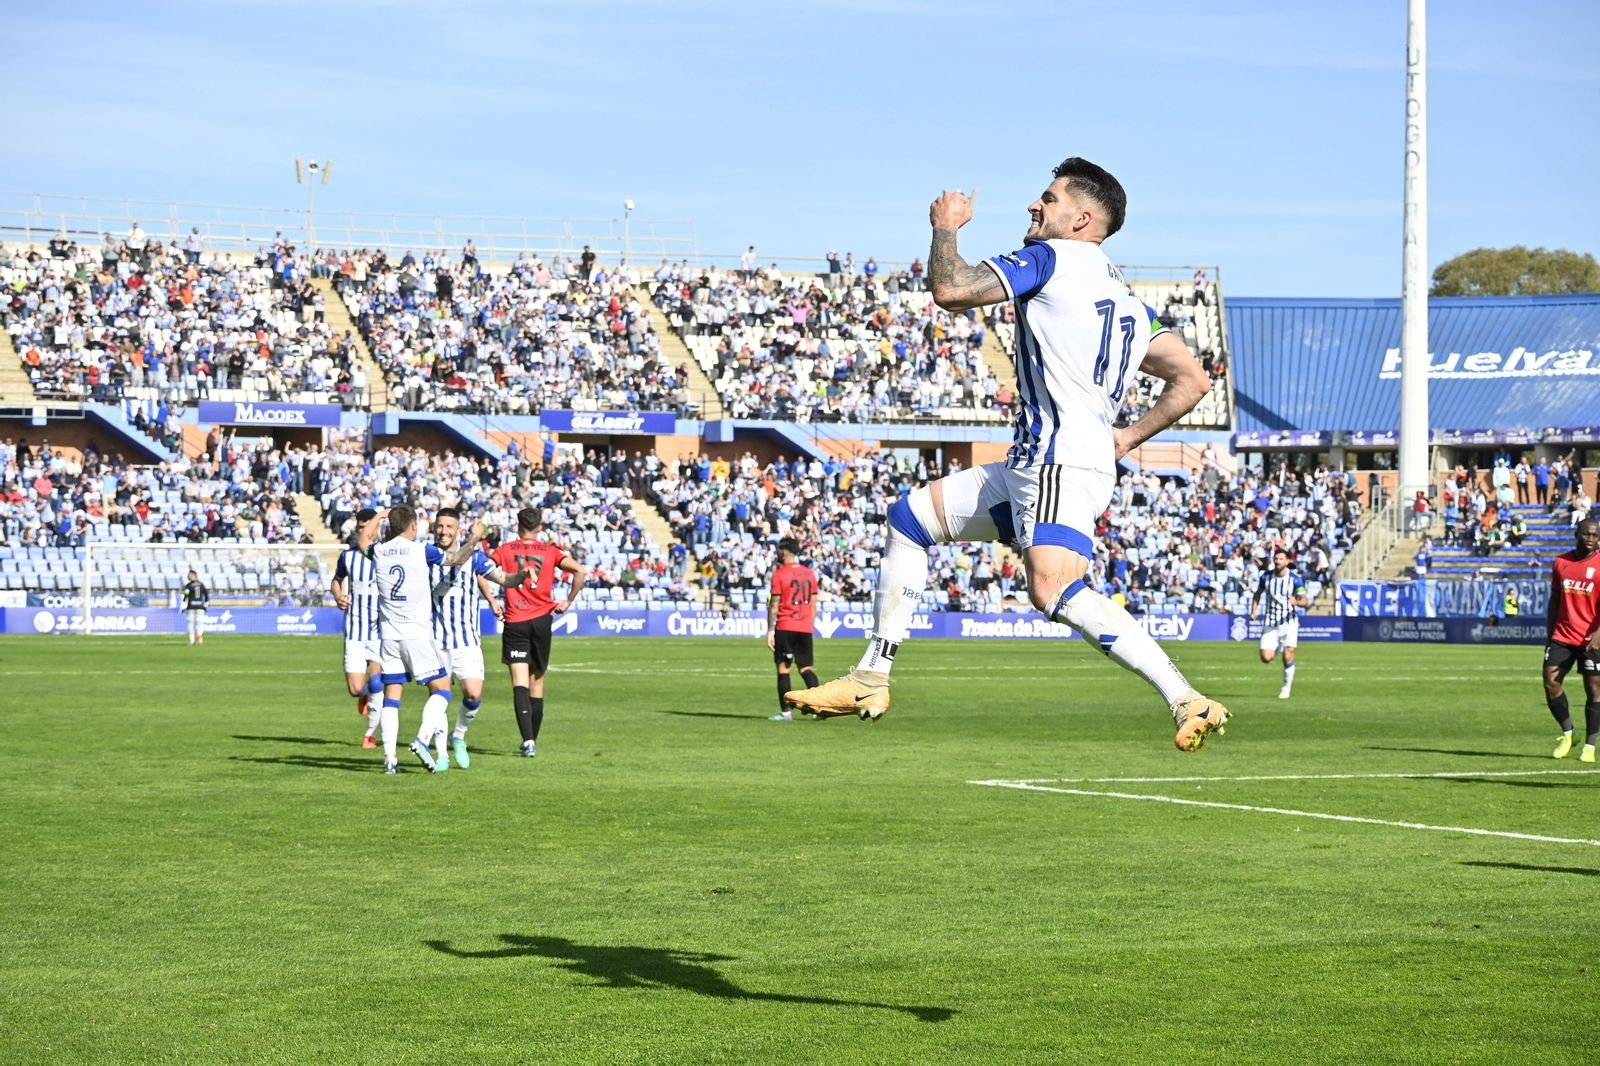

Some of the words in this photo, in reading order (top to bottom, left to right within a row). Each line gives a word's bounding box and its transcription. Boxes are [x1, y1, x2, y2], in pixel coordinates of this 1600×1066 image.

[1094, 299, 1136, 402] 11
[571, 417, 645, 430] GILABERT
[514, 555, 544, 589] 17
[389, 565, 407, 601] 2
[790, 579, 812, 606] 20
[902, 586, 922, 600] 188
[1340, 584, 1416, 617] FREN
[43, 596, 130, 608] COMPIANCE
[597, 615, 646, 633] Veyser
[667, 611, 769, 638] Cruzcamp
[843, 613, 874, 629] CAJ
[1014, 618, 1032, 637] de
[1394, 621, 1416, 630] HOTEL
[1418, 620, 1444, 631] MARTÍN
[1392, 631, 1419, 640] ALONSO
[1421, 630, 1446, 640] PINZÓN
[1483, 625, 1522, 638] ATRACCIONES
[1522, 626, 1531, 638] LA
